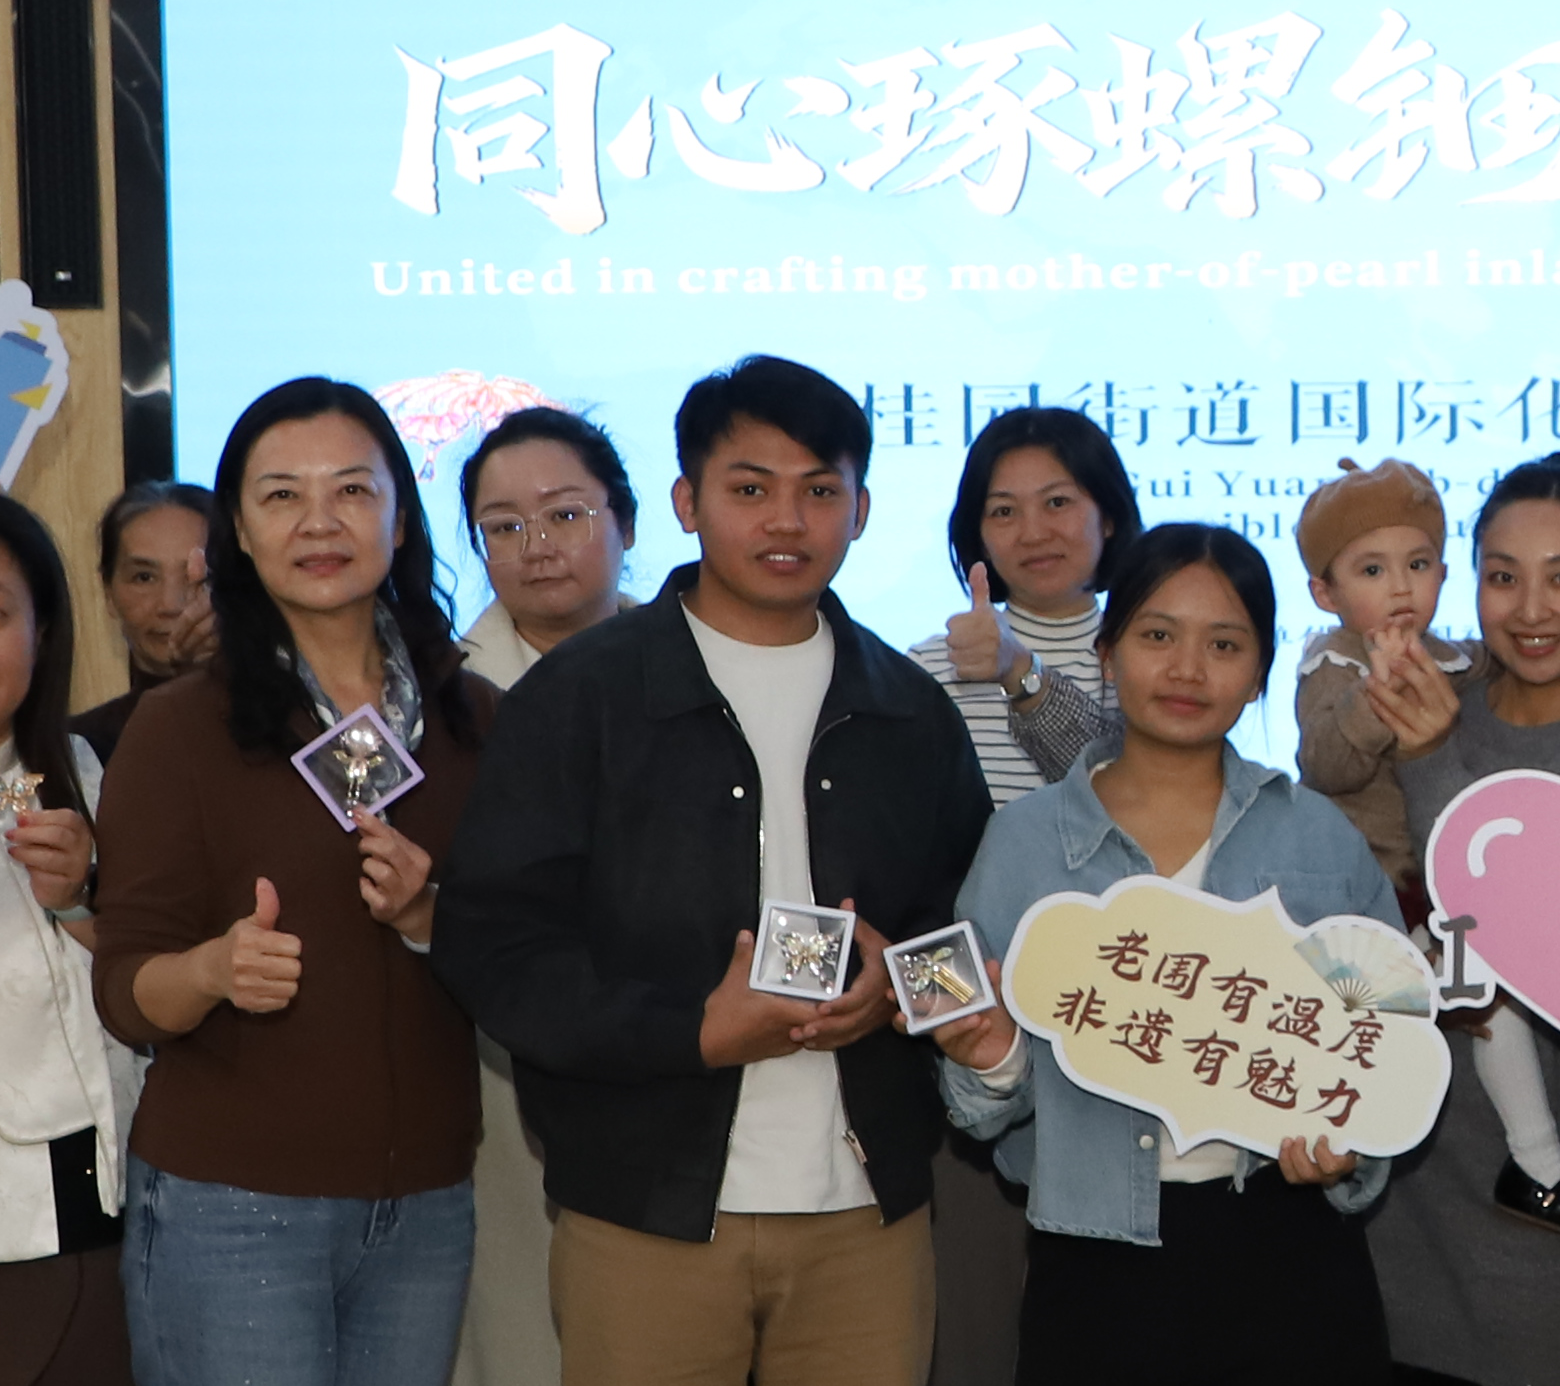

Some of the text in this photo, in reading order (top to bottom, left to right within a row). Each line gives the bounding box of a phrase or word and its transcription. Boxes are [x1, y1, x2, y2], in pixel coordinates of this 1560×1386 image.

[369, 256, 575, 297] United
[597, 256, 656, 296] in
[677, 254, 930, 302] crafting
[948, 250, 1439, 299] mother-of-pearl
[1097, 928, 1385, 1070] 老围有温度
[1438, 914, 1487, 1003] I
[1051, 985, 1362, 1128] 非遗有魅力
